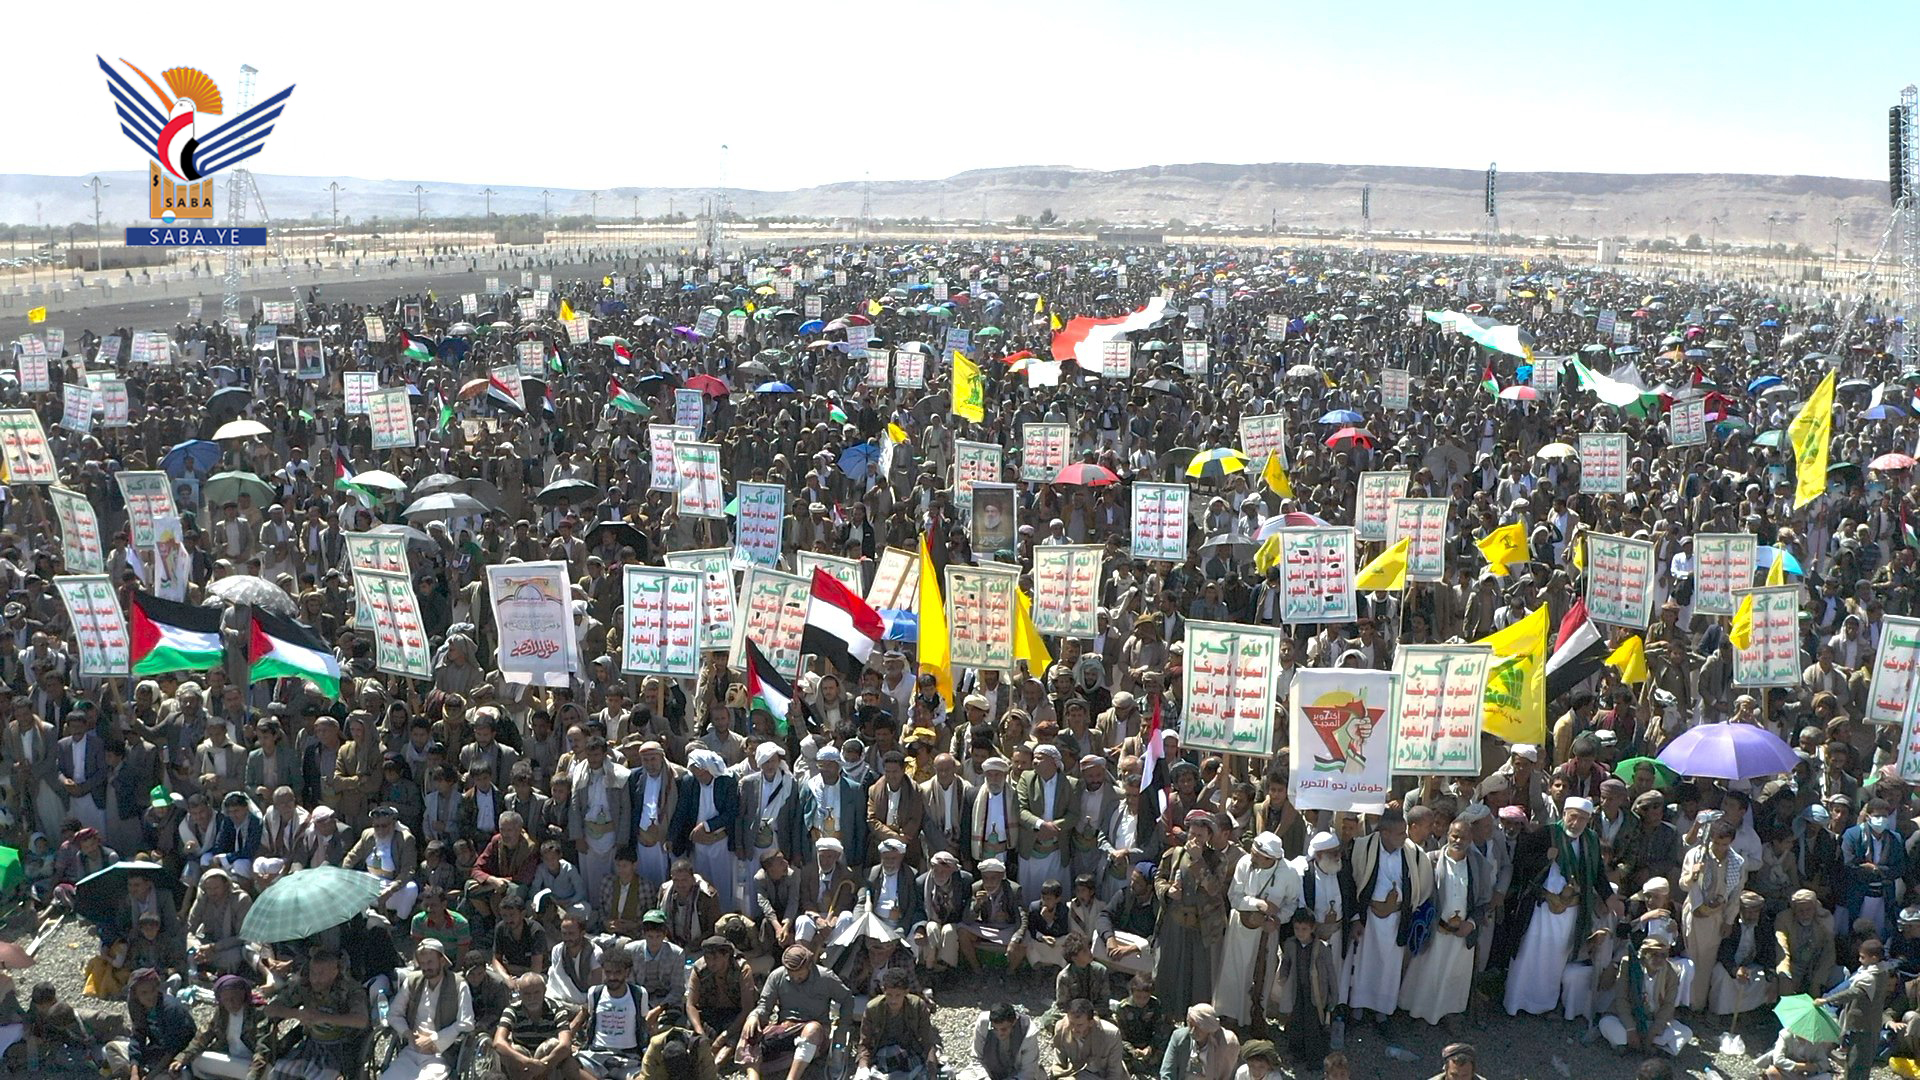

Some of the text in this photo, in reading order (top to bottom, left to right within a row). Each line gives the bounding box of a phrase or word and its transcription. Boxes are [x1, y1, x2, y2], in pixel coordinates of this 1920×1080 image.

[671, 578, 694, 593] الله
[667, 599, 693, 614] الموت
[666, 617, 692, 631] الموت
[1241, 637, 1269, 657] الله
[664, 649, 691, 669] النصر
[1455, 656, 1482, 674] الله
[1234, 663, 1267, 681] الموت
[1233, 684, 1265, 702] الموت
[1447, 682, 1477, 698] الموت
[1190, 700, 1217, 717] اليهود
[1444, 703, 1474, 720] الموت
[1228, 722, 1262, 747] النصر
[1440, 742, 1473, 766] النصر
[1300, 779, 1383, 793] طوفان نحو التحرير
